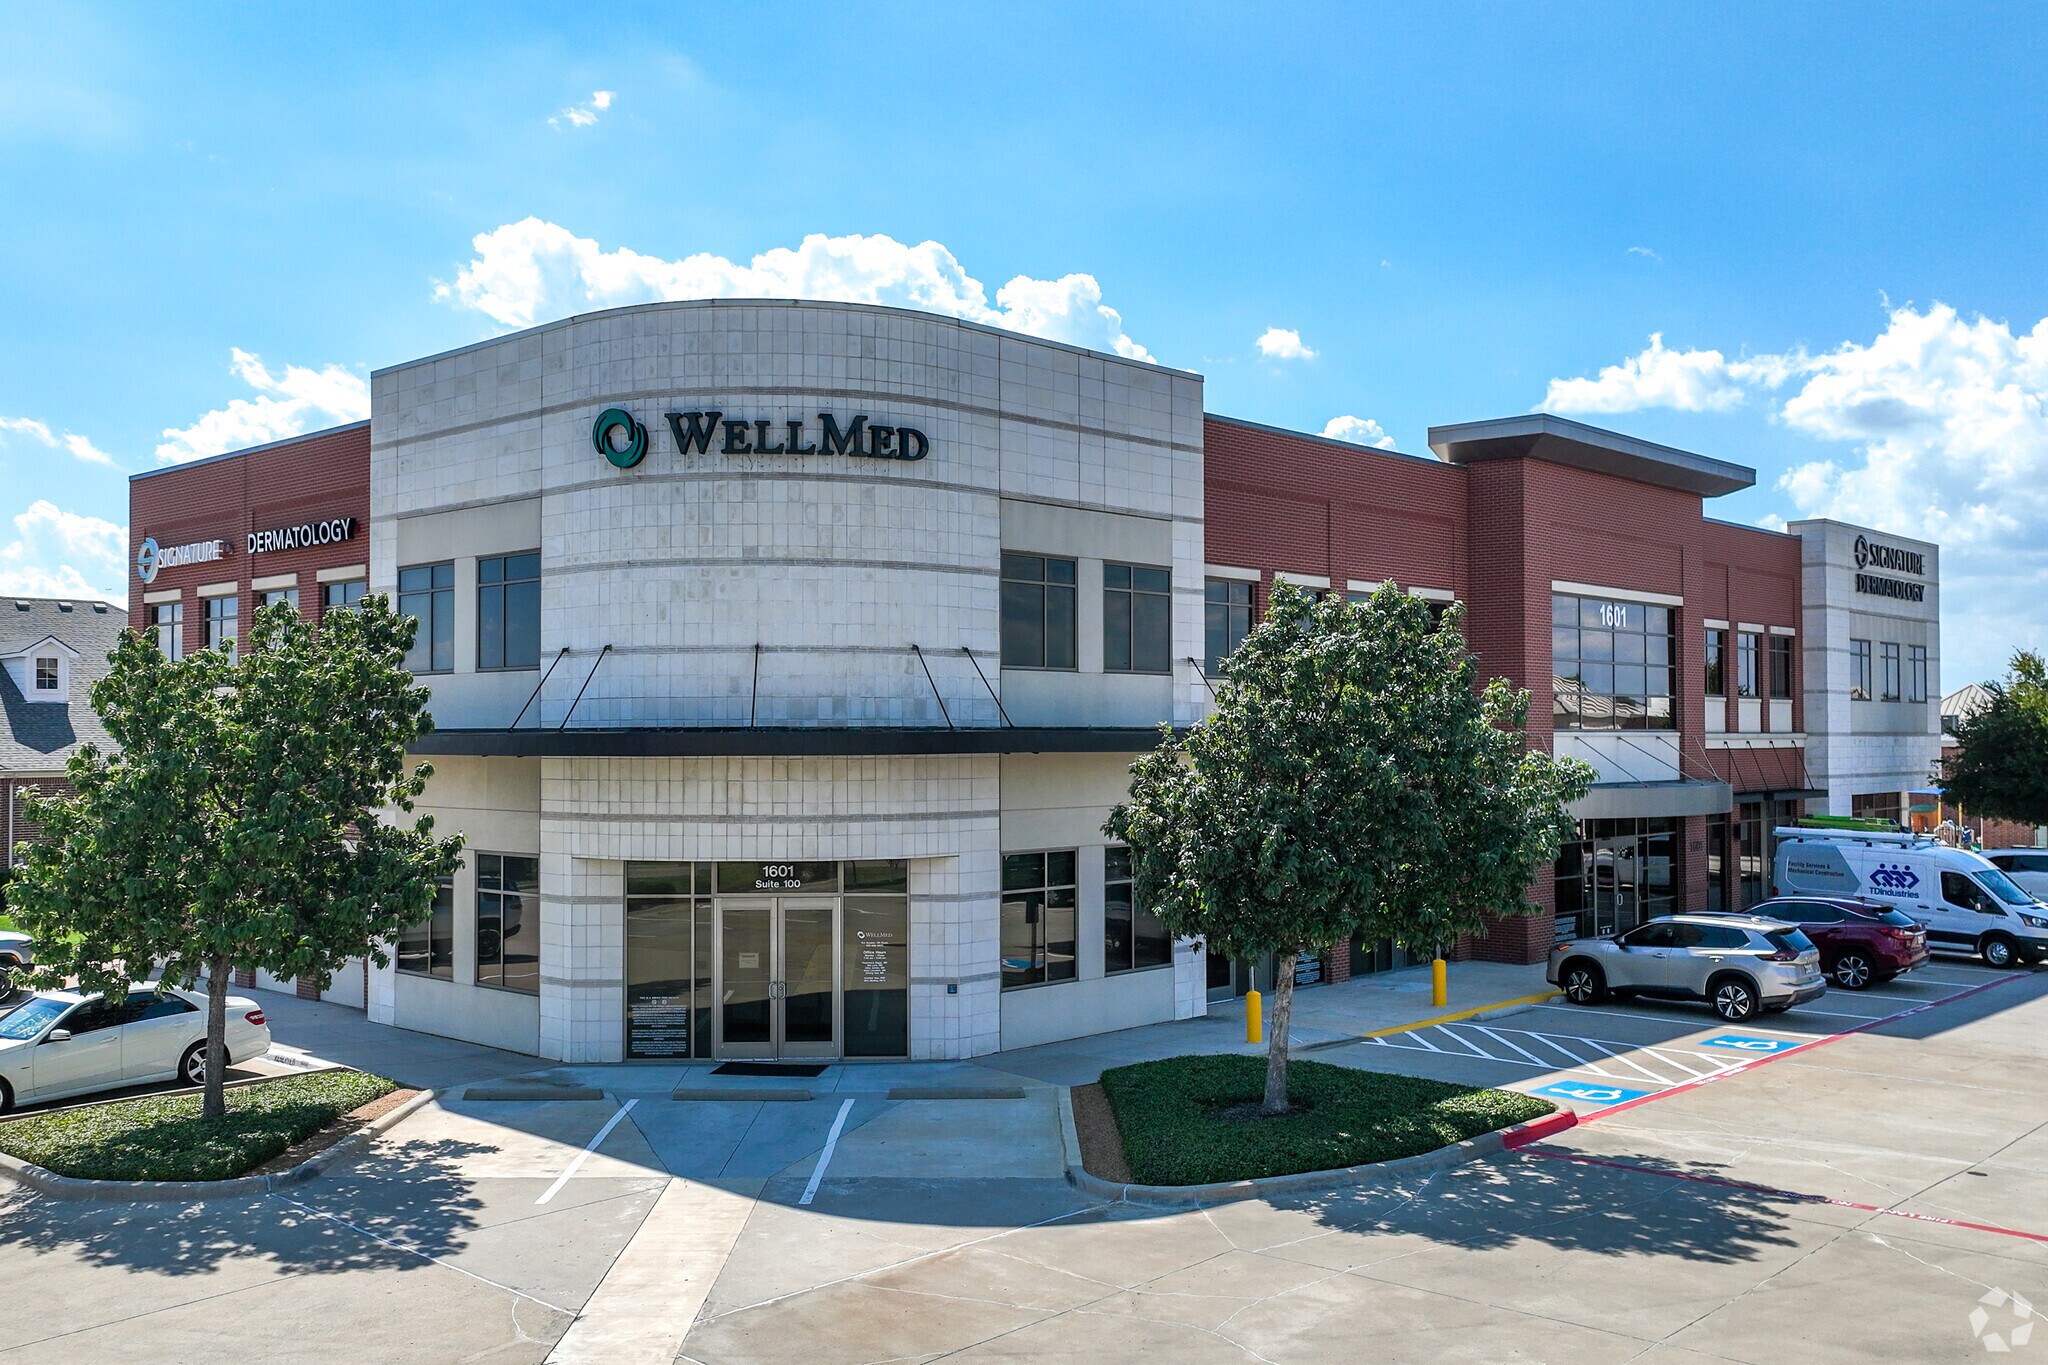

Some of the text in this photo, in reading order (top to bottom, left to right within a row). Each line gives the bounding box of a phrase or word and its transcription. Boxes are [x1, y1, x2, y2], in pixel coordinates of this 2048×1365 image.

[158, 517, 355, 568] SIGNATURE DERMATOLOGY
[1869, 543, 1925, 575] SIGNATURE
[1855, 573, 1925, 602] DERMATOLOGY
[1600, 604, 1626, 628] 1601
[762, 865, 794, 878] 1601
[1788, 867, 1844, 877] Mechanical Construction
[755, 879, 801, 889] Suite 100
[1868, 886, 1920, 899] TDIndustries
